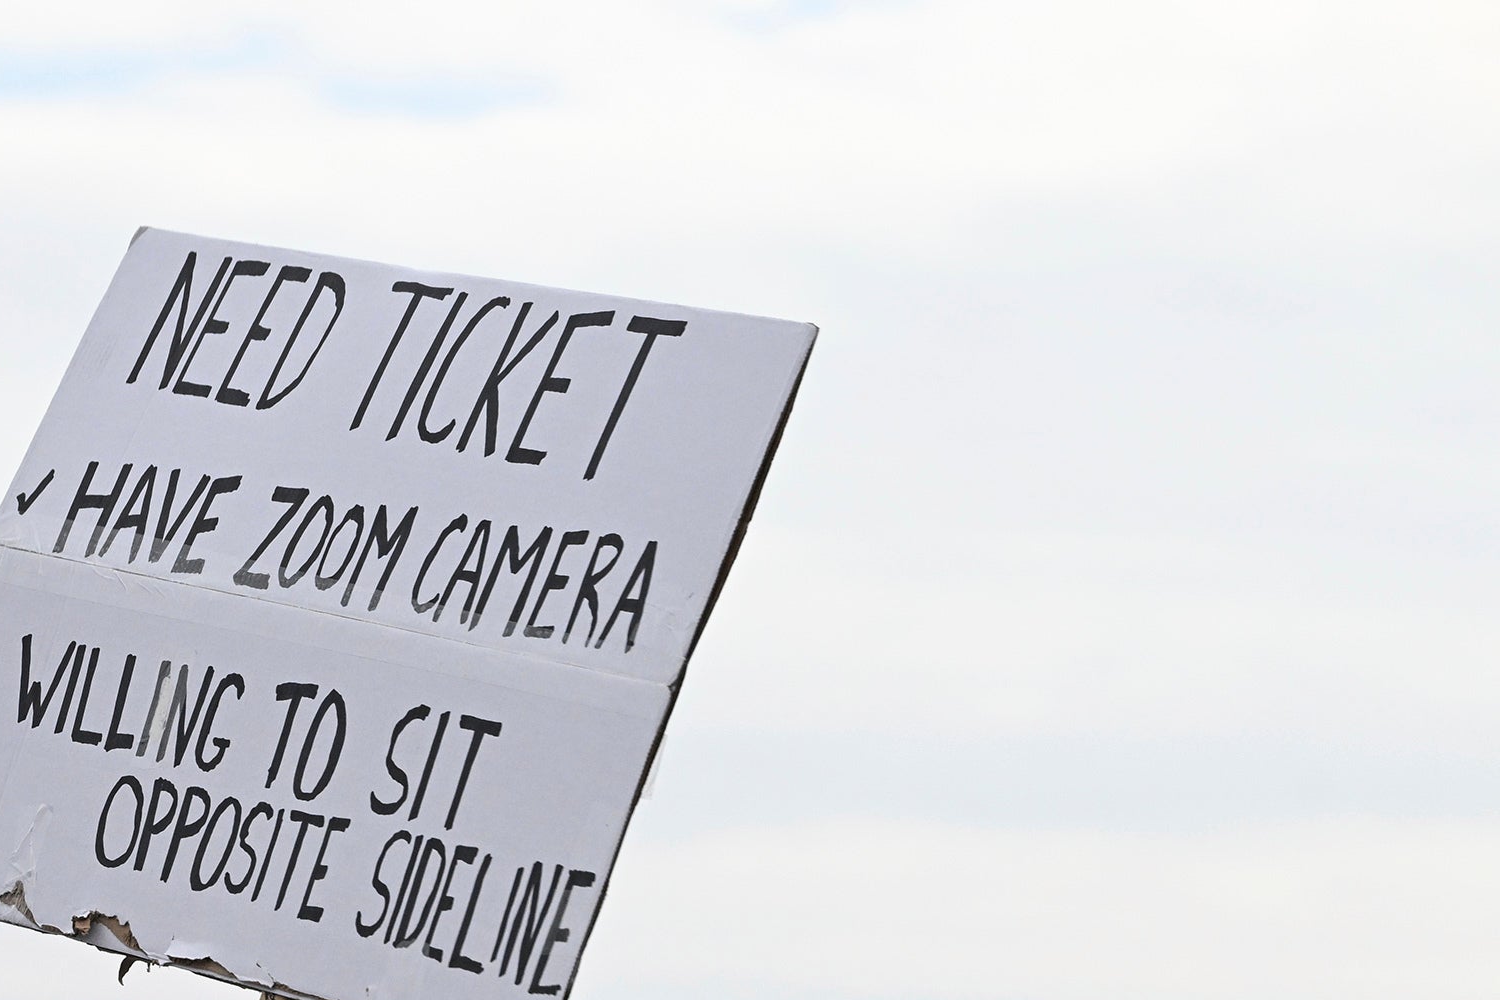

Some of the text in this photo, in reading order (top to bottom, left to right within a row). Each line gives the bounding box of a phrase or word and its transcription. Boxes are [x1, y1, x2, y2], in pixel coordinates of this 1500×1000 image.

[126, 250, 687, 482] NEED TICKET
[52, 460, 659, 654] HAVE ZOOM CAMERA
[16, 633, 503, 831] WILLING TO SIT
[94, 774, 597, 997] OPPOSITE SIDELINE
